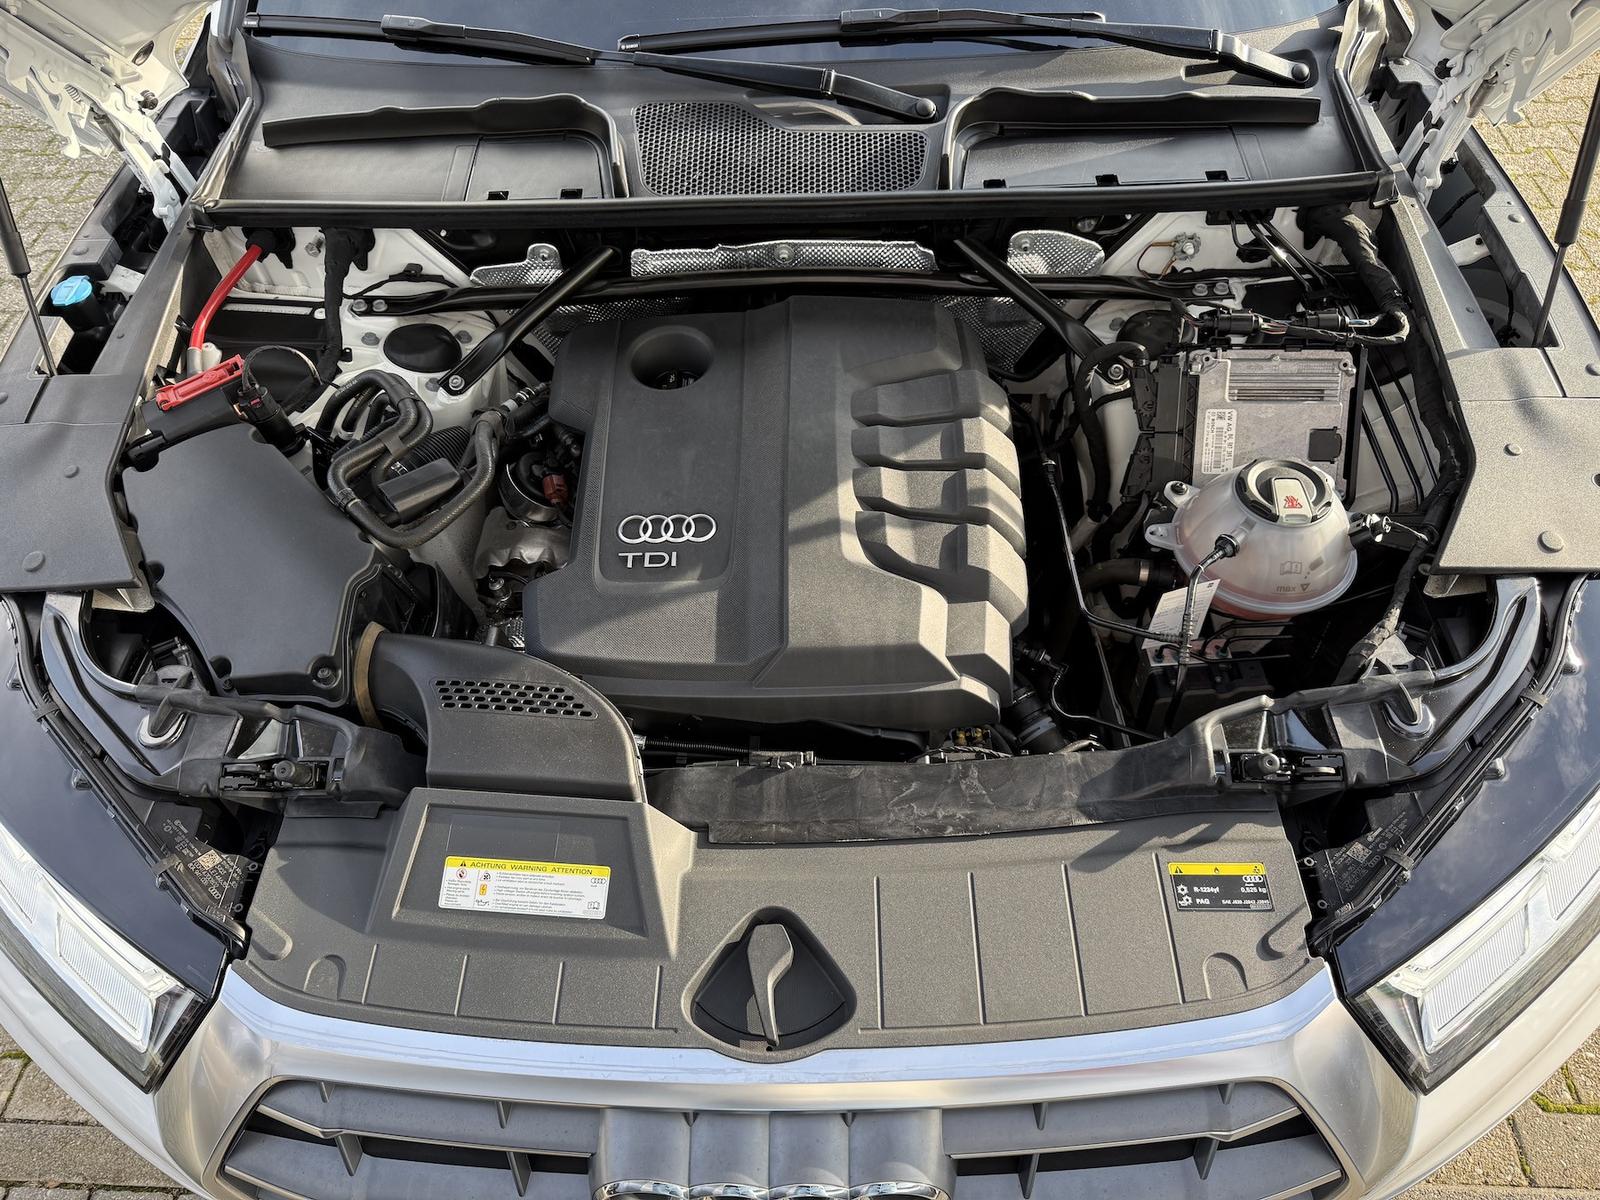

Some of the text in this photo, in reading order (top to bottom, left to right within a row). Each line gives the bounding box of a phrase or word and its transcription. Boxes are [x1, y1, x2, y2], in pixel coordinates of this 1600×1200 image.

[618, 551, 677, 569] TDI
[470, 861, 593, 875] ACHTUNG WARNING ATTENTION
